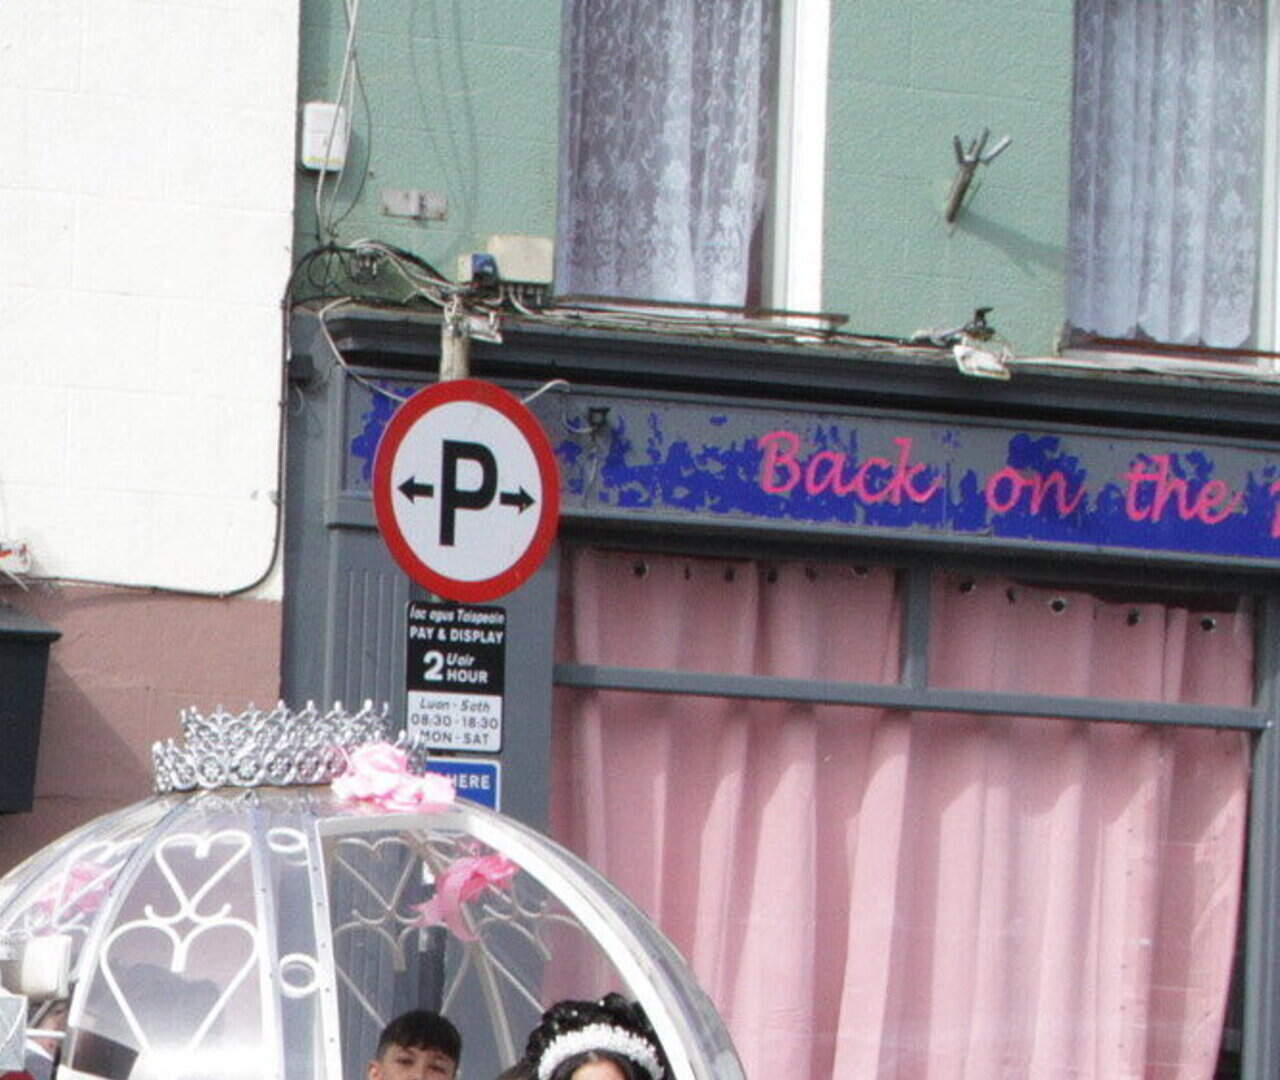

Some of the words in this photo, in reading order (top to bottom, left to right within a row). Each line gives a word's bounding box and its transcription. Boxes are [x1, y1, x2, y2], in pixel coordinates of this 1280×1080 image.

[758, 431, 941, 505] Back
[984, 466, 1086, 516] on
[1121, 454, 1243, 524] the
[439, 439, 498, 546] P
[409, 625, 434, 640] PAY
[450, 628, 504, 645] DISPLAY
[423, 650, 444, 681] 2
[446, 652, 475, 667] Uair
[446, 668, 488, 684] HOUR
[419, 730, 452, 744] MON
[463, 733, 489, 746] SAT
